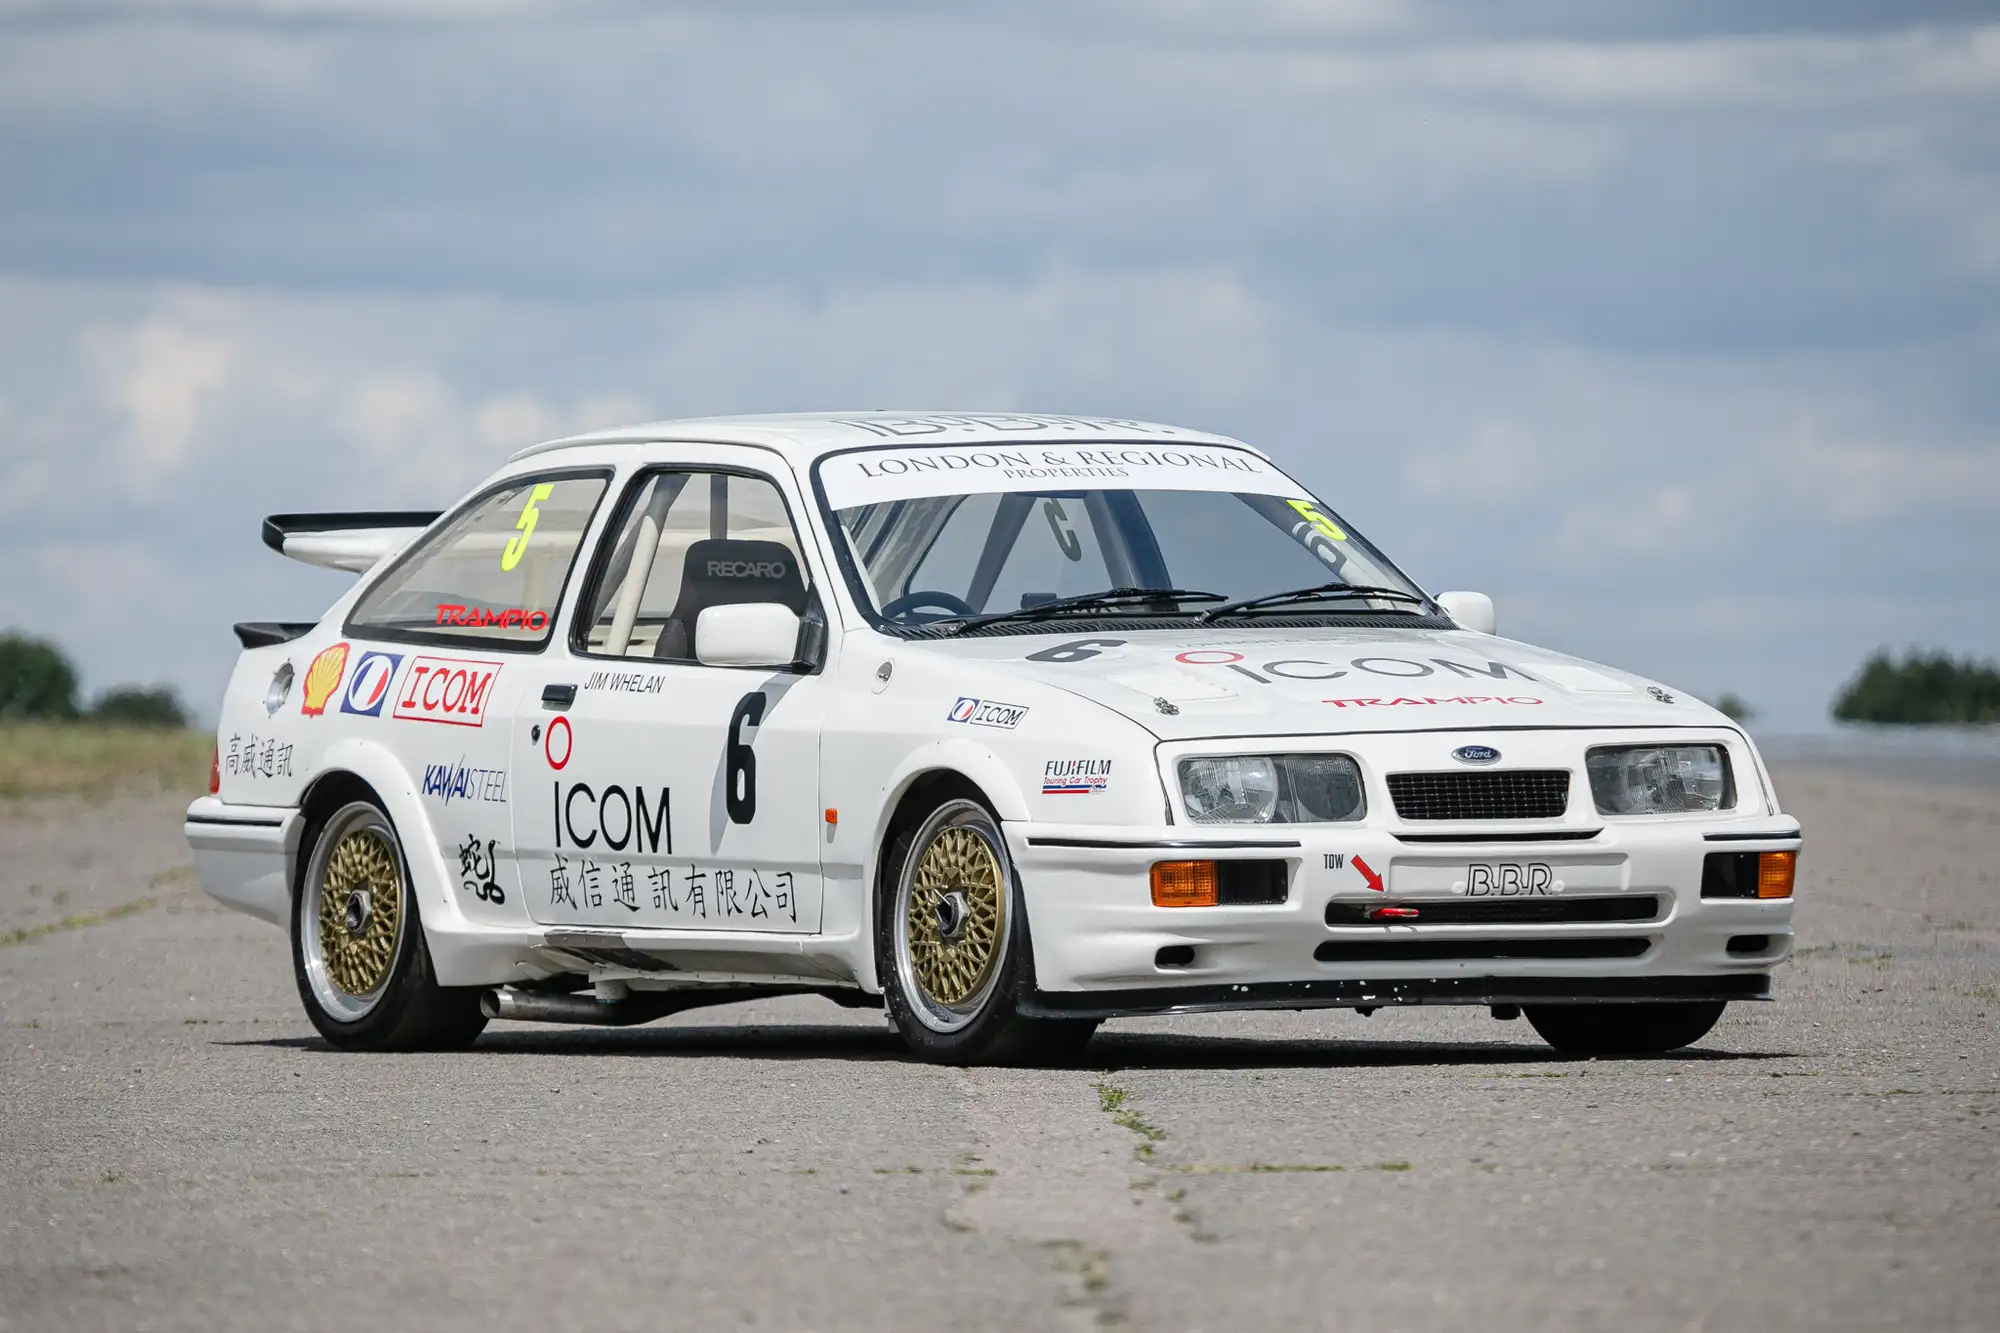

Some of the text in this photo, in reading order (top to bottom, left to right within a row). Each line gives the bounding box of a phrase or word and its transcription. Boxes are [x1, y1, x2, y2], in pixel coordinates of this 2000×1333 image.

[857, 451, 1263, 477] LONDON & REGIONAL
[1003, 467, 1130, 479] PROPERTIES
[501, 484, 555, 572] 5
[1285, 500, 1348, 541] 5
[707, 560, 786, 579] RECARO
[436, 604, 549, 631] TRAMPIO
[1025, 639, 1128, 662] 6
[1226, 657, 1539, 684] ICOM
[402, 666, 492, 714] ICOM
[584, 672, 665, 694] JIM WHELAN
[1322, 696, 1543, 708] TRAMPIO
[975, 705, 1024, 726] ICOM
[726, 691, 767, 824] 6
[1464, 747, 1493, 759] Ford
[1045, 759, 1112, 776] FUJIFILM
[1044, 775, 1107, 786] Touring Car Trophy
[554, 781, 672, 855] ICOM
[1323, 853, 1344, 869] TOW
[549, 853, 797, 924] 威信通訊有限公司
